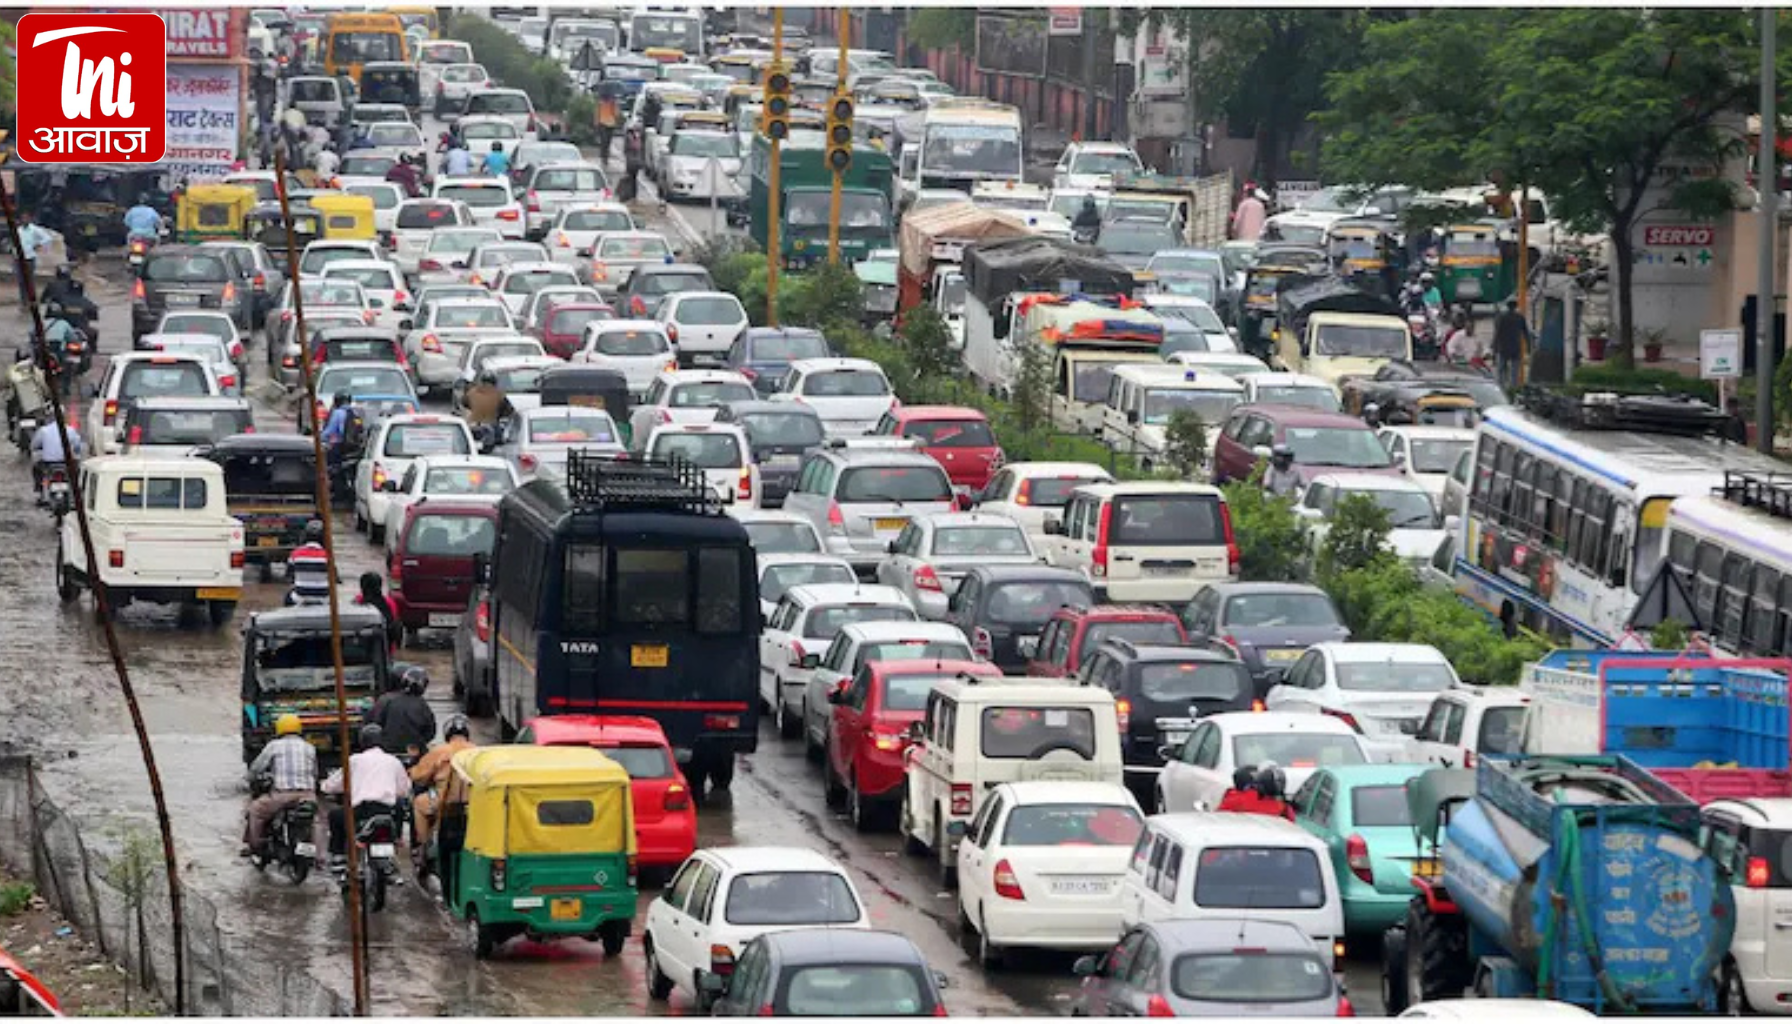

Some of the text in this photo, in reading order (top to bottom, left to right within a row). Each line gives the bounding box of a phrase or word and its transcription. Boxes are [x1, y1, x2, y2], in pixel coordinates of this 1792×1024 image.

[167, 42, 227, 54] RAVELS
[1648, 229, 1710, 244] SERVO
[560, 642, 599, 653] TATA
